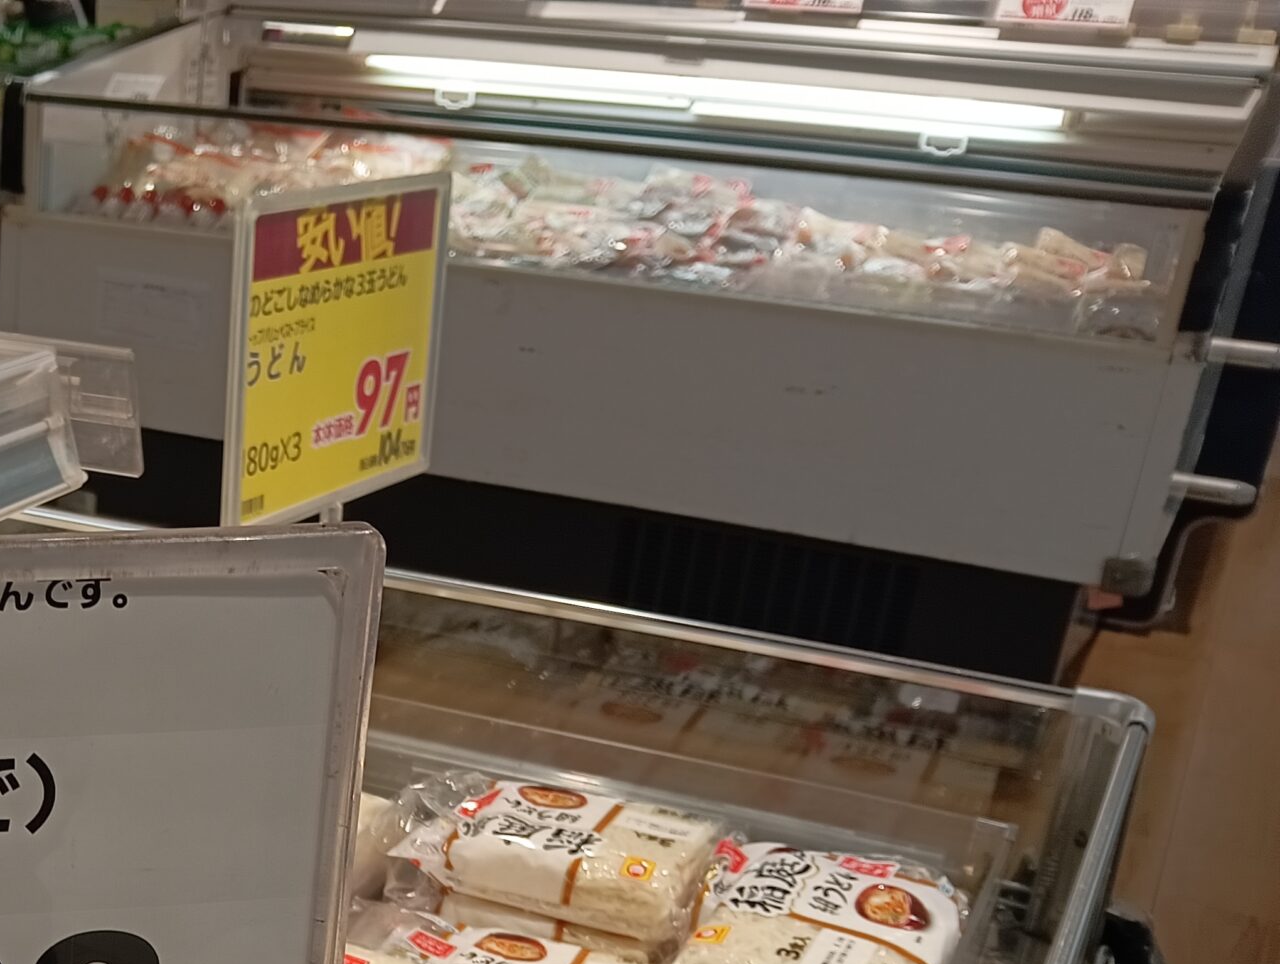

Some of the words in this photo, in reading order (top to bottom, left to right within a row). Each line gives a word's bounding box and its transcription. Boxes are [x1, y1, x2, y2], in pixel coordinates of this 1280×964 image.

[246, 341, 307, 388] うどん
[354, 351, 421, 437] 97円
